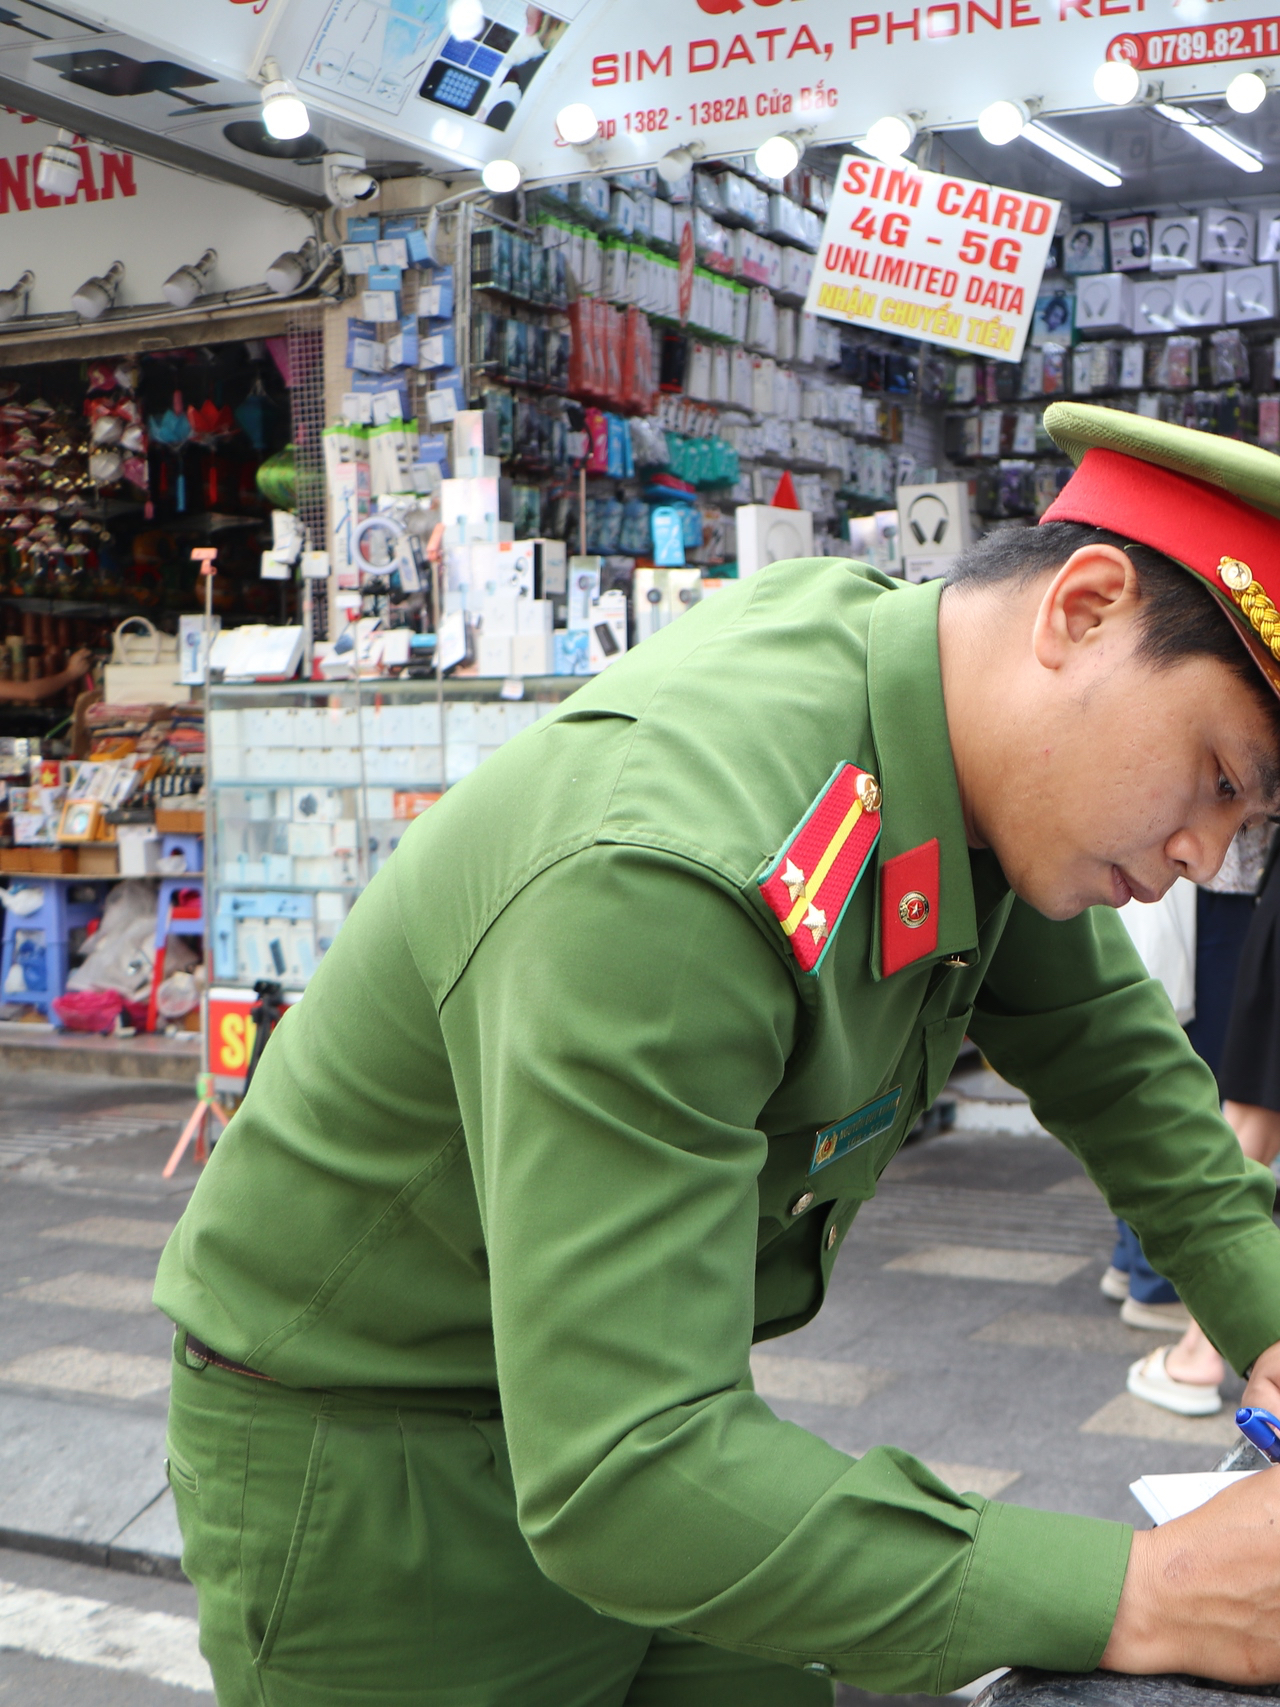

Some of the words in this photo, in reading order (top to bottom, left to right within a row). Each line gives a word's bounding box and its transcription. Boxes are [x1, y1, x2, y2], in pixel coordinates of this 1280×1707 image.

[592, 45, 672, 87] SIM
[688, 24, 834, 73] DATA,
[850, 0, 1040, 49] PHONE
[623, 107, 669, 134] 1382
[689, 96, 749, 126] 1382A
[756, 87, 792, 116] Cửa
[843, 161, 923, 207] SIM
[936, 182, 1053, 236] CARD
[850, 206, 912, 248] 4G
[926, 236, 943, 245] -
[958, 229, 1023, 274] 5G
[824, 243, 959, 298] UNLIMITED
[965, 275, 1025, 315] DATA
[817, 282, 878, 320] NHẬN
[879, 297, 964, 339] CHUYỂN
[967, 315, 1016, 351] TIỀN
